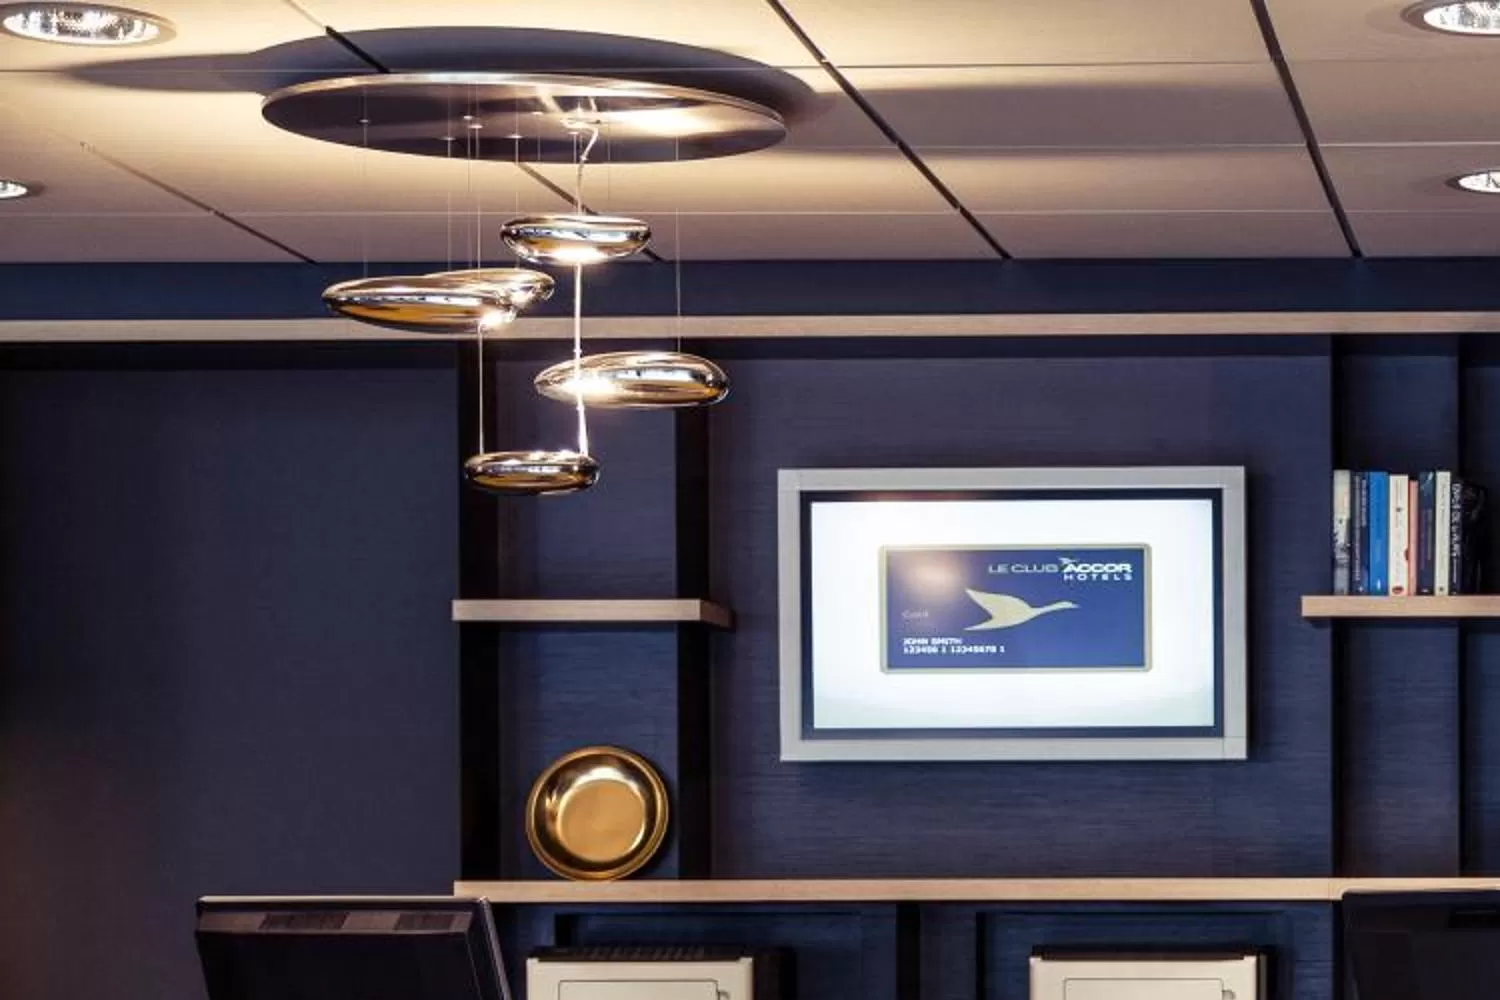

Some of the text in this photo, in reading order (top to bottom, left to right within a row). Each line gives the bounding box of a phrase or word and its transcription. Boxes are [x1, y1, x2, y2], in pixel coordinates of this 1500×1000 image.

[988, 564, 1009, 574] LE
[1011, 563, 1059, 574] CLUB
[903, 637, 963, 645] JOHN SMITH
